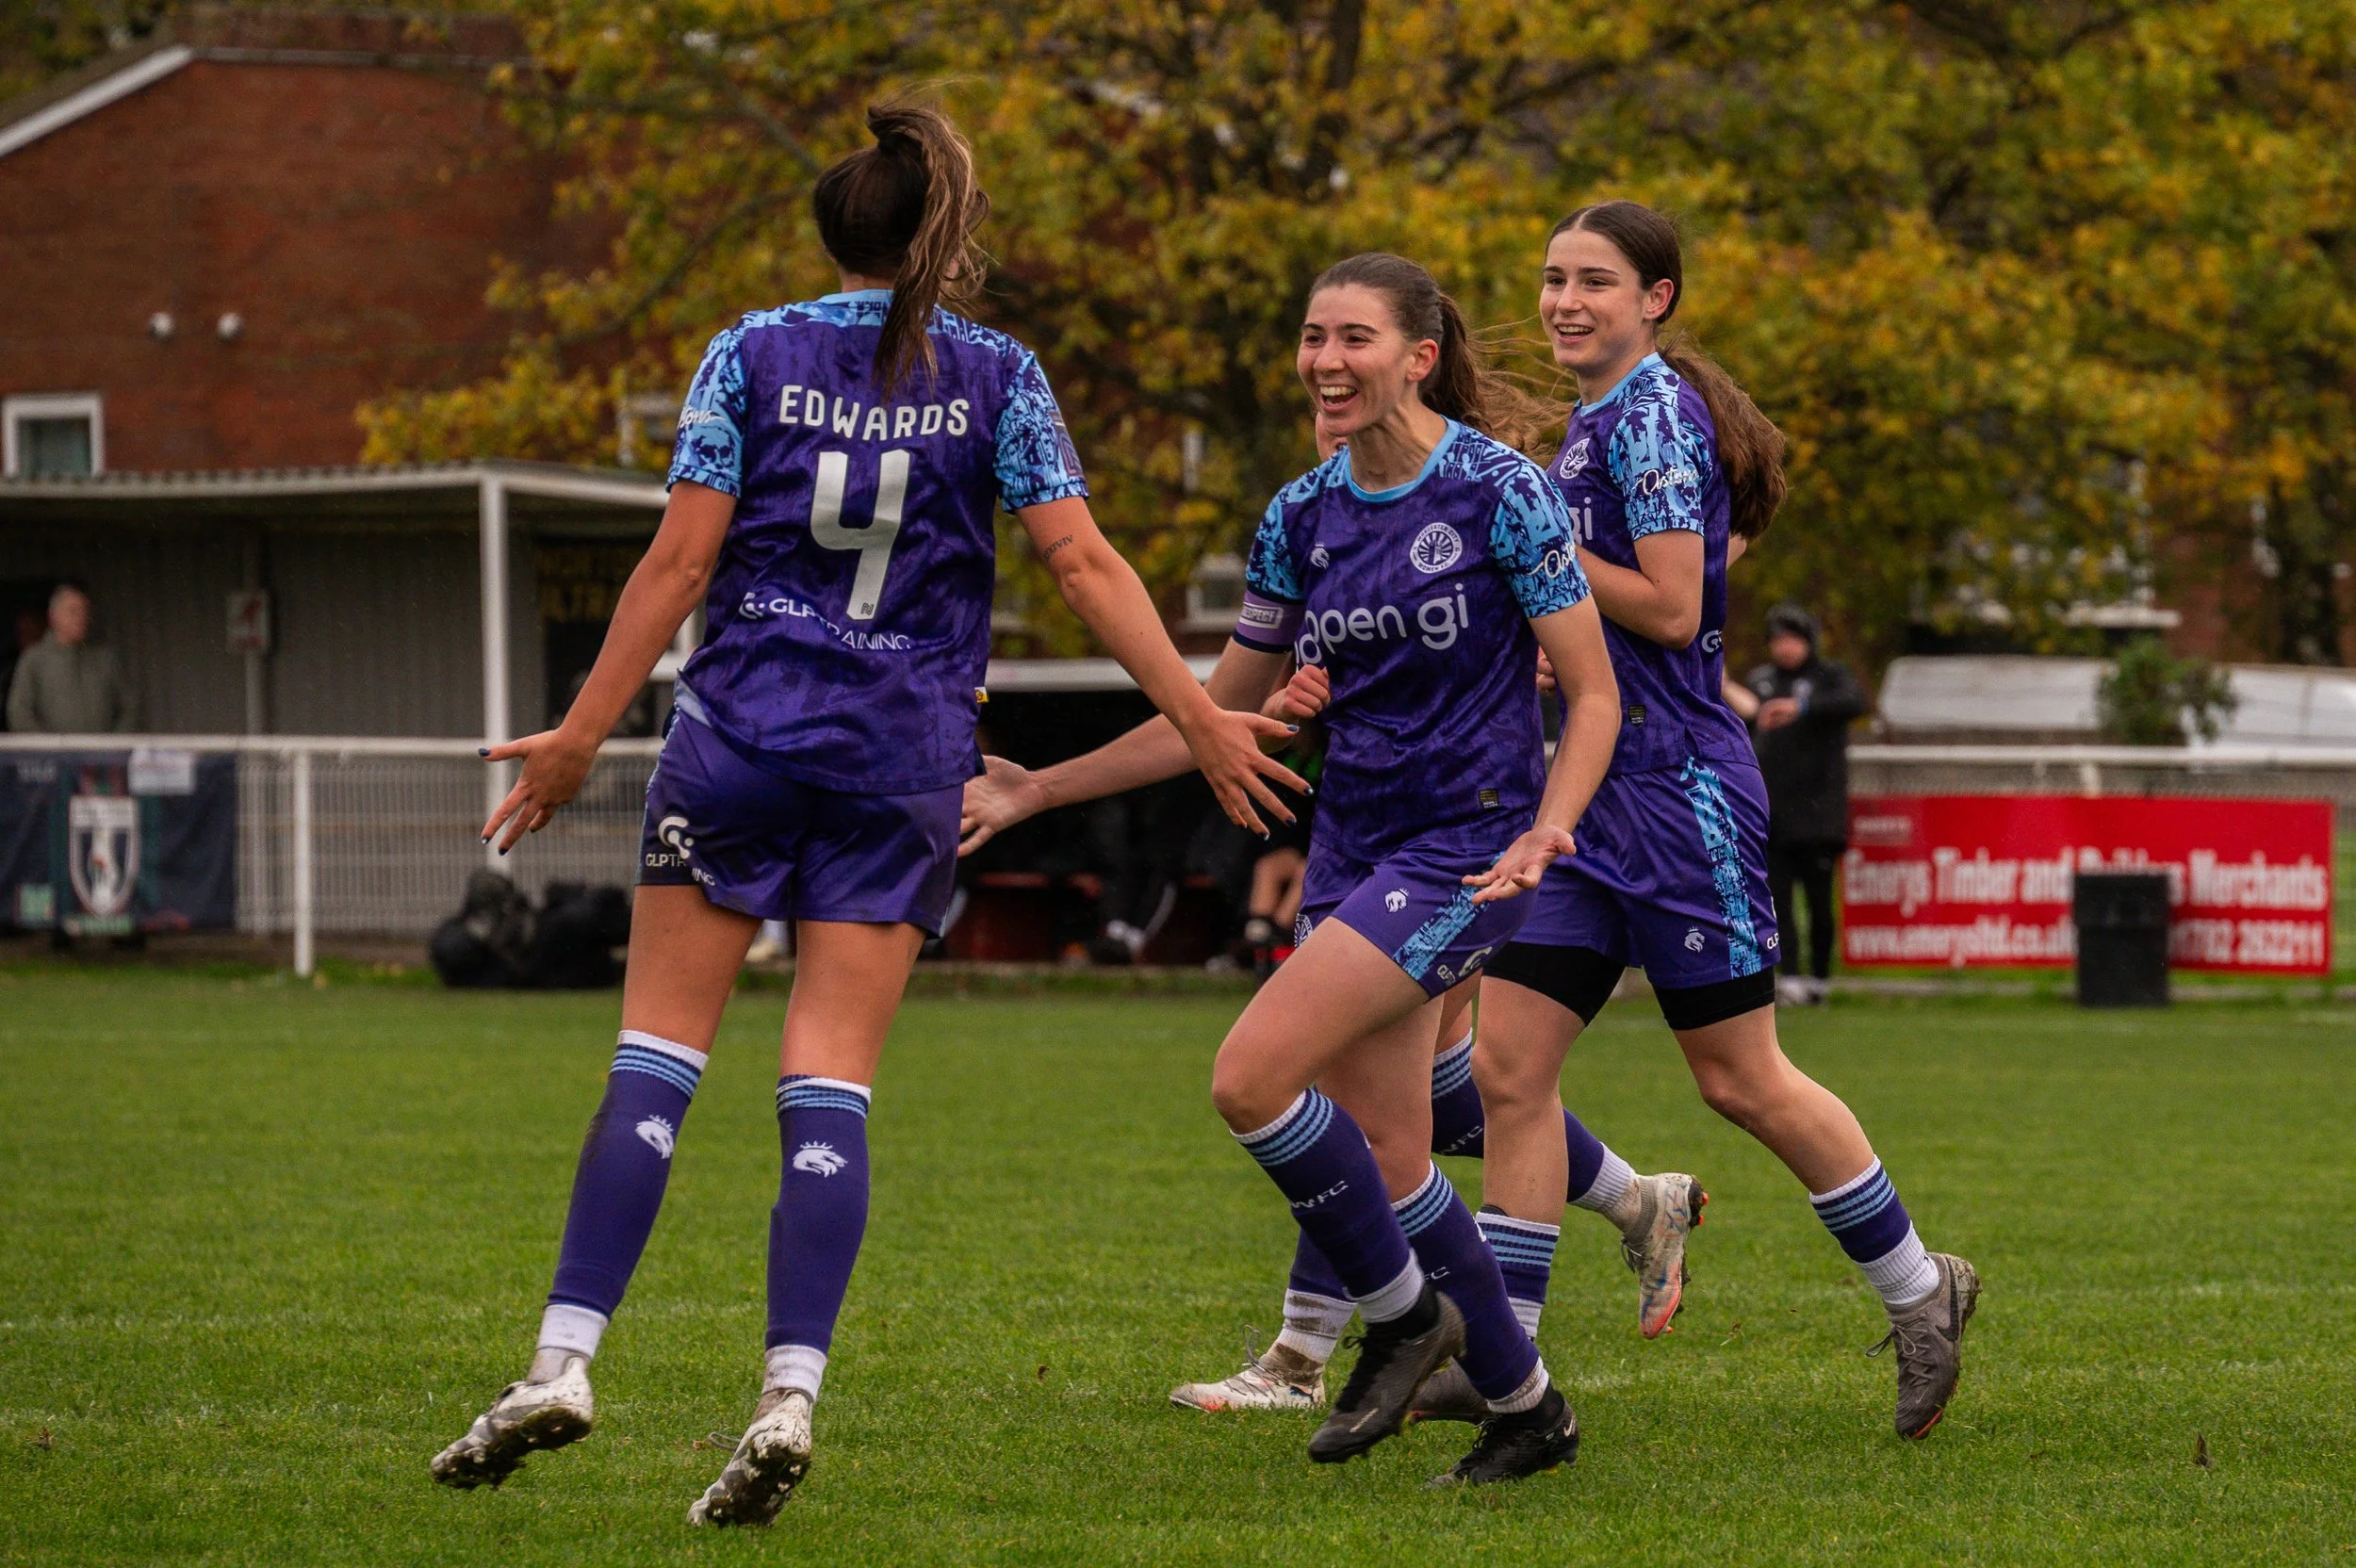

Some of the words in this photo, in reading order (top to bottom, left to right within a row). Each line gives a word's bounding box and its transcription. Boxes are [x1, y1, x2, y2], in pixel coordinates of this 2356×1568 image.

[779, 384, 970, 441] EDWARDS
[810, 449, 910, 620] 4
[1416, 582, 1470, 651] gi
